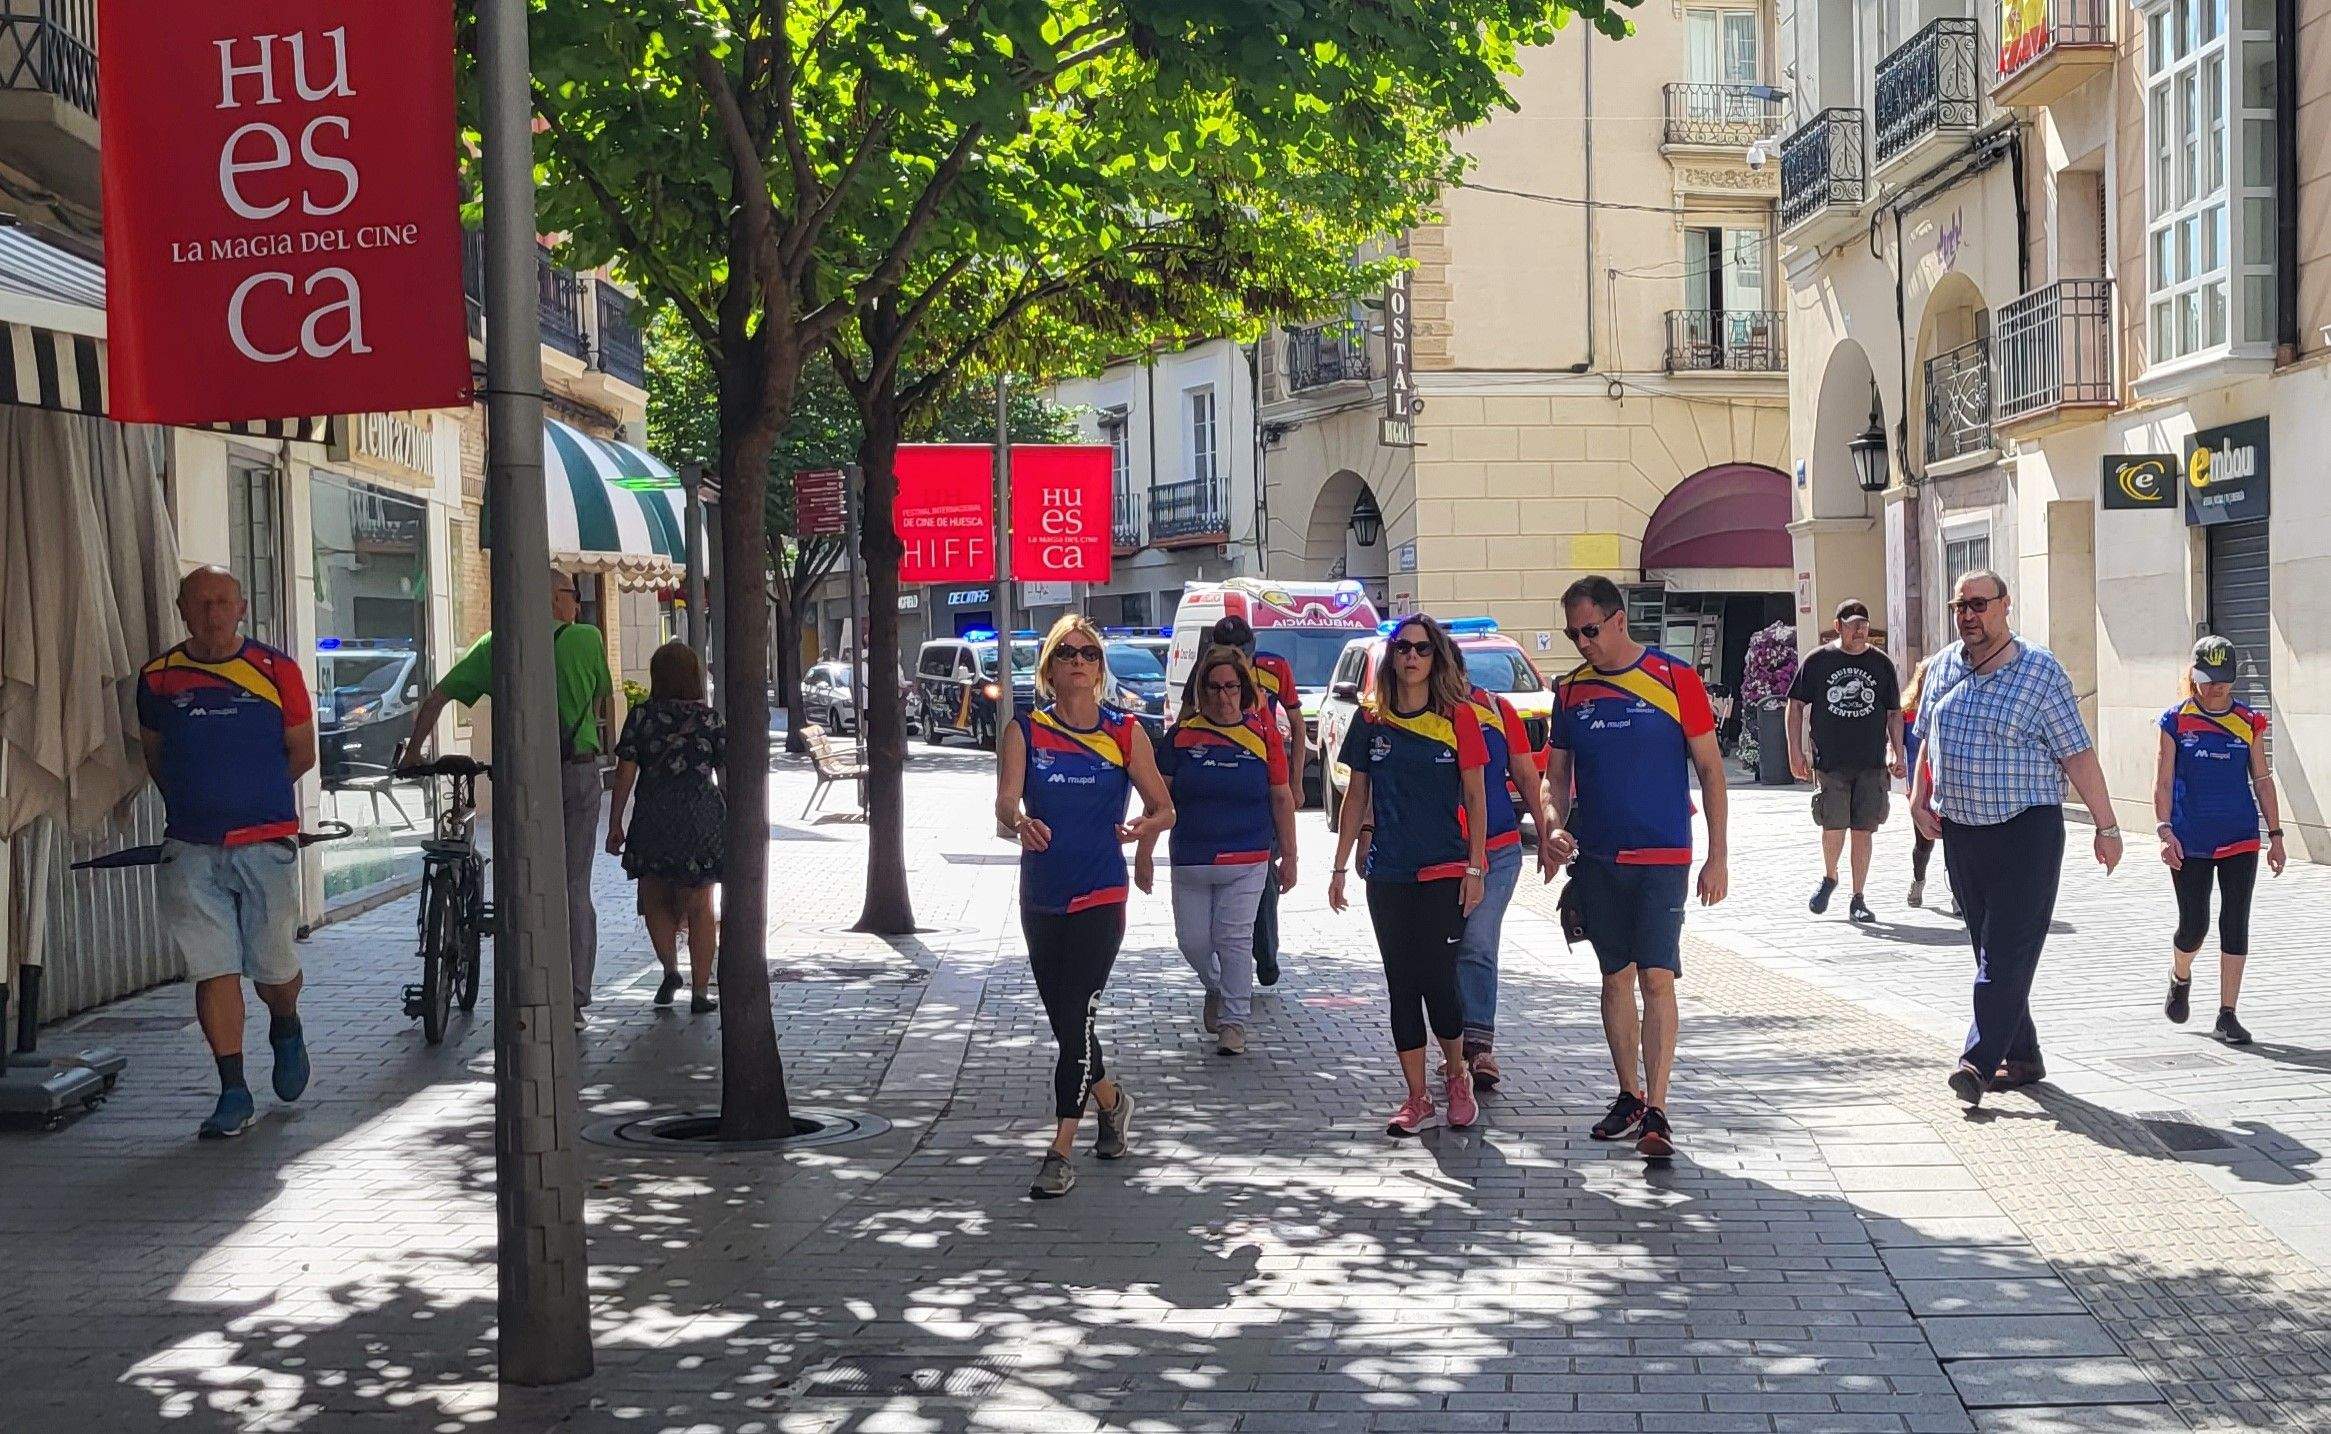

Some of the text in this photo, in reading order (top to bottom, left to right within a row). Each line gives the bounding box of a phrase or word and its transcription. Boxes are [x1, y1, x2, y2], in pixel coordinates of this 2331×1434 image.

[219, 115, 359, 220] es
[1391, 270, 1407, 415] HOSTAL
[2189, 437, 2255, 488] embou
[903, 516, 984, 527] DE CINE DE HUESCA
[903, 538, 984, 568] HIFF
[947, 589, 990, 606] DECIMAS
[1826, 667, 1877, 686] LOUISVILLE
[1828, 703, 1875, 717] KENTUCKY
